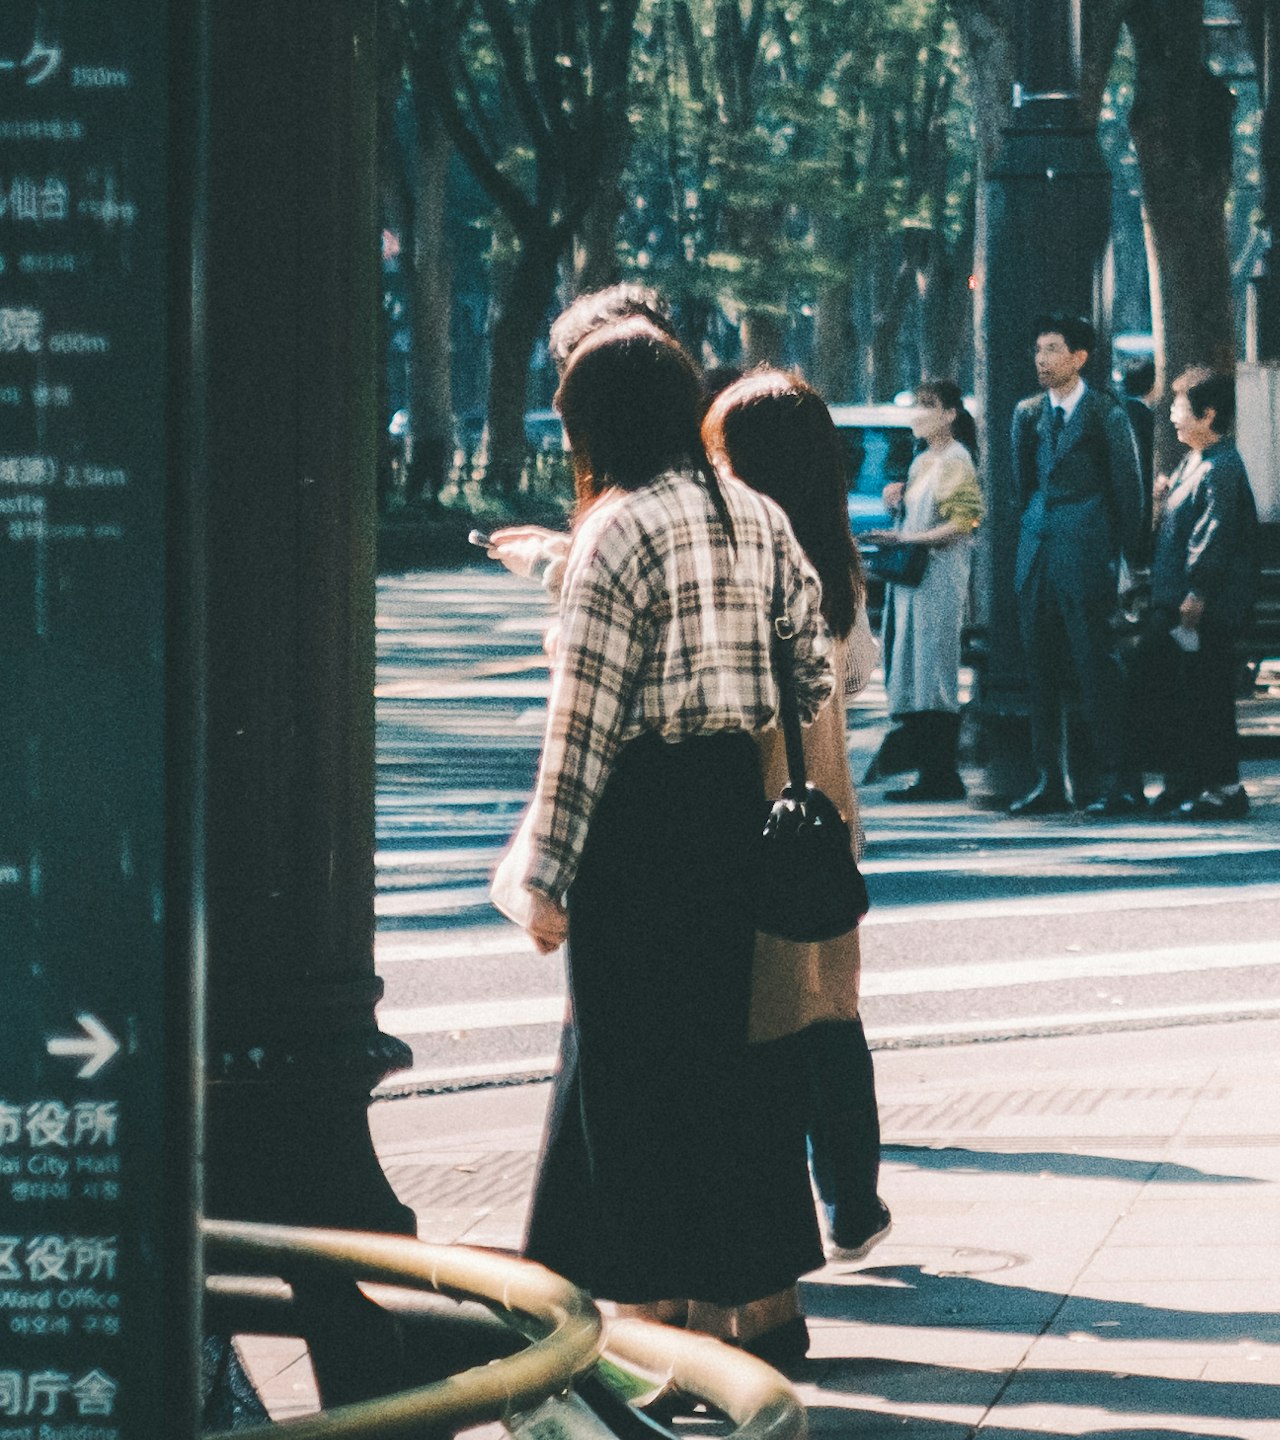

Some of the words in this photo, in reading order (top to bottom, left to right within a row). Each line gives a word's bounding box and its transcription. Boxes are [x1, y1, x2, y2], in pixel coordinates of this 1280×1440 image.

[0, 177, 69, 220] 仙台
[27, 1154, 69, 1179] City
[76, 1154, 120, 1174] Hall
[57, 1288, 120, 1310] Office
